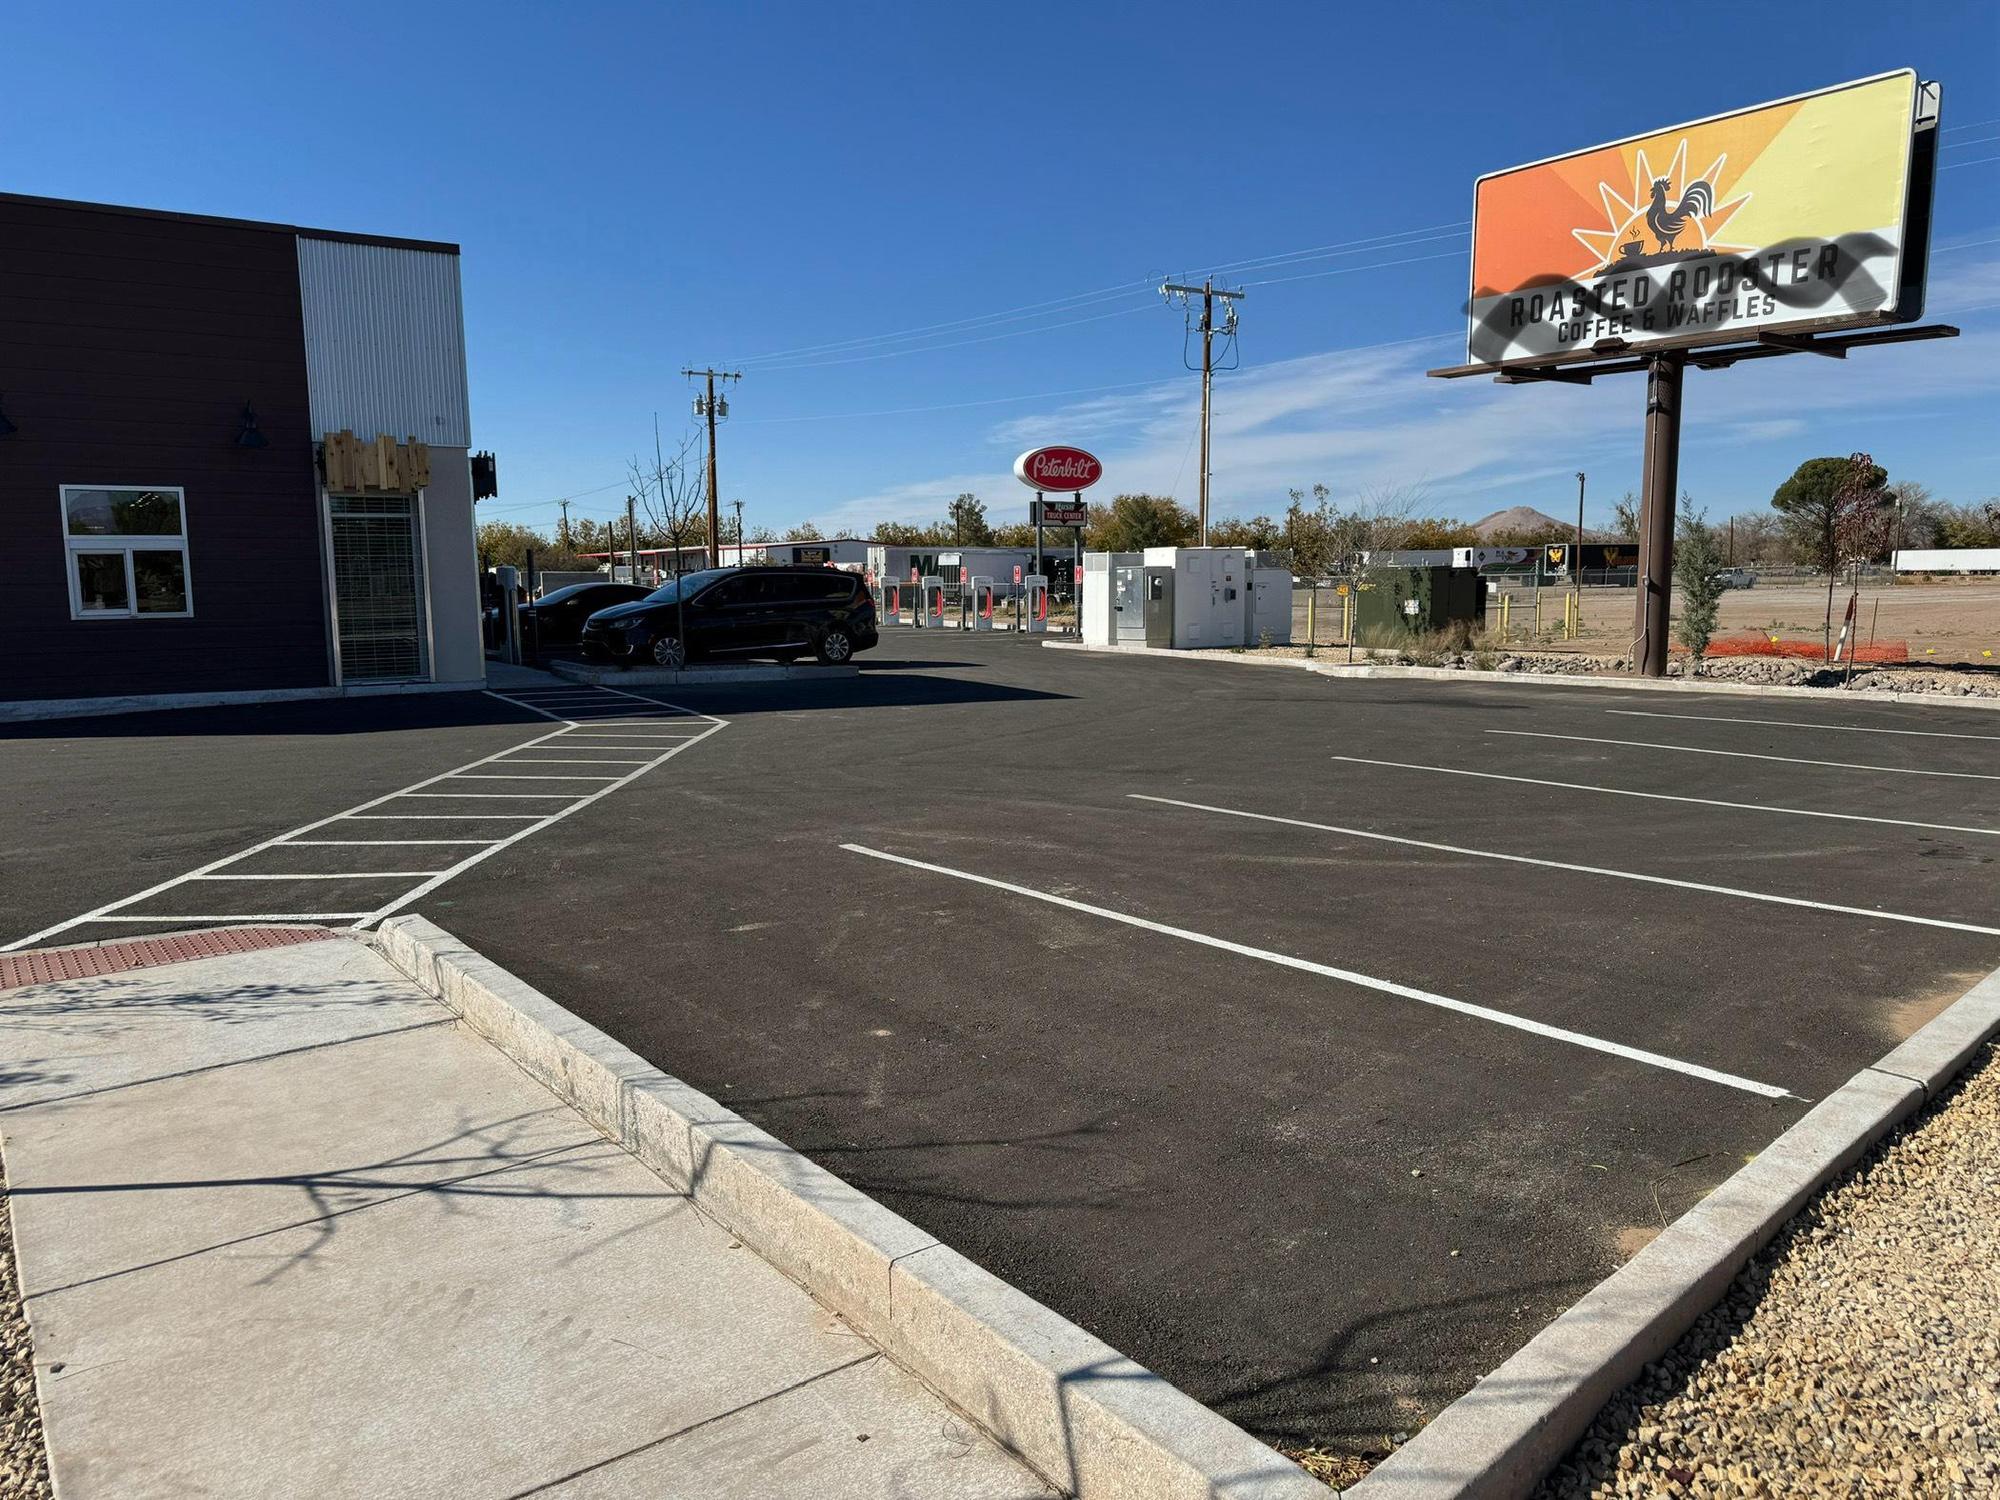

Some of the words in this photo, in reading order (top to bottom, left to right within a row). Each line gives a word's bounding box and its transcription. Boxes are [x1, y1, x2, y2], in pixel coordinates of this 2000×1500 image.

[1510, 275, 1650, 328] ROASTED
[1668, 243, 1839, 303] ROOSTER
[1557, 313, 1633, 343] COFFEE
[1642, 307, 1656, 331] &
[1666, 293, 1776, 328] WAFFLES
[1033, 453, 1096, 479] Peterbilt
